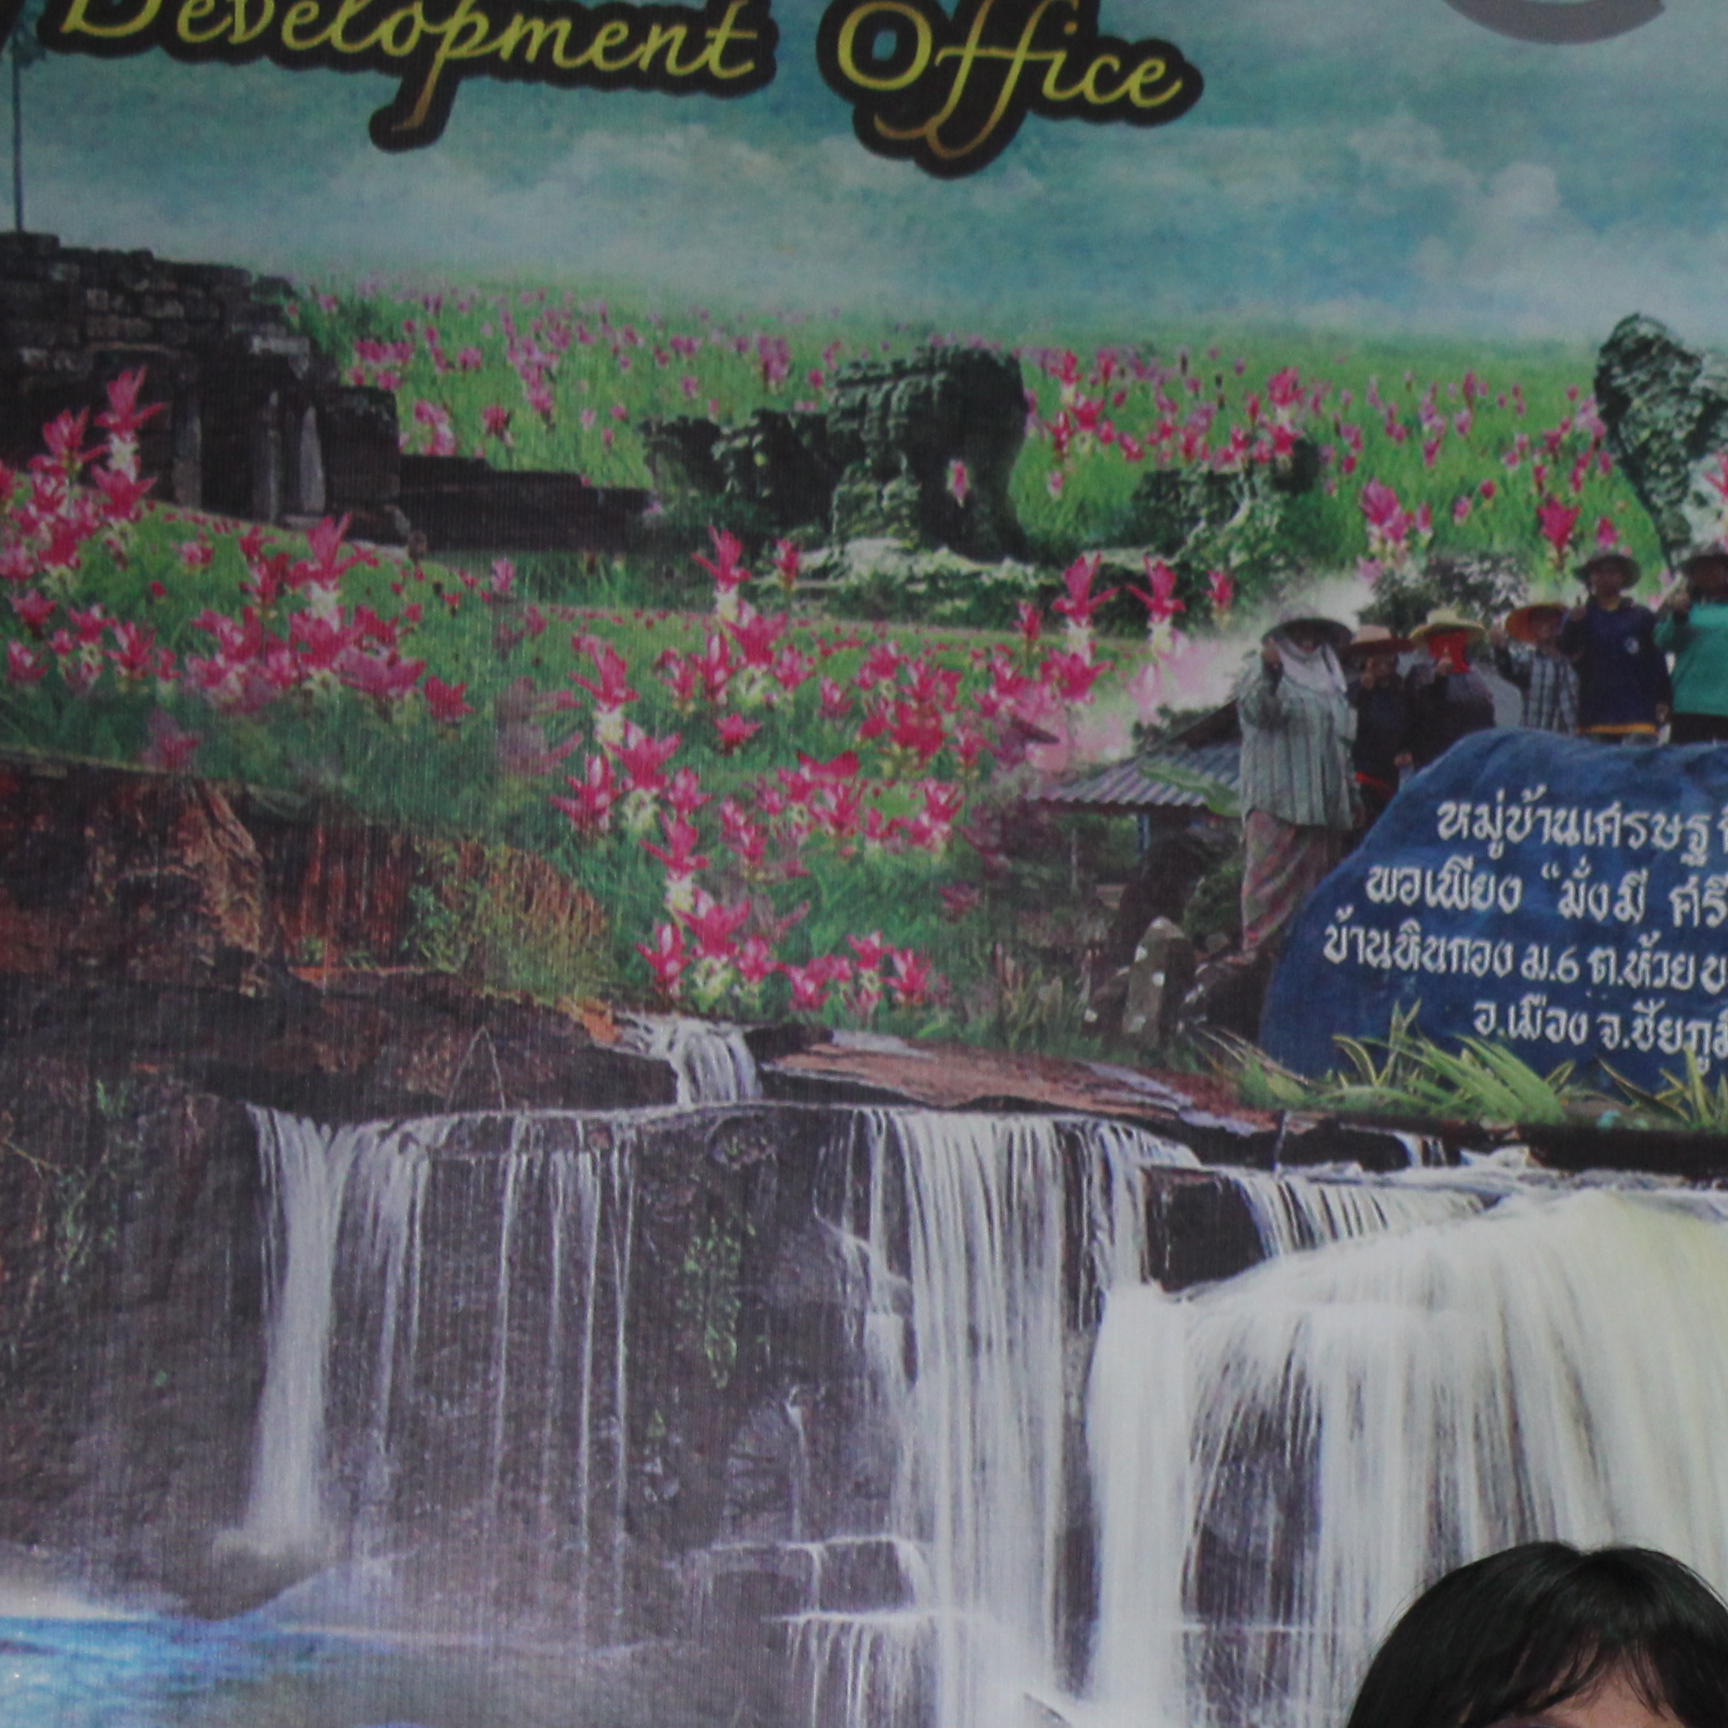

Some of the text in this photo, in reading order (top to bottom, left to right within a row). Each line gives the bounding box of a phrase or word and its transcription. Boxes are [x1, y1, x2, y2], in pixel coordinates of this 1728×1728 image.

[836, 0, 1184, 159] Office
[1366, 854, 1523, 915] พอเพียง
[1322, 905, 1514, 978] บ้านหินกอง
[1520, 944, 1580, 984] ม.6
[1472, 995, 1589, 1046] อ.เมือง
